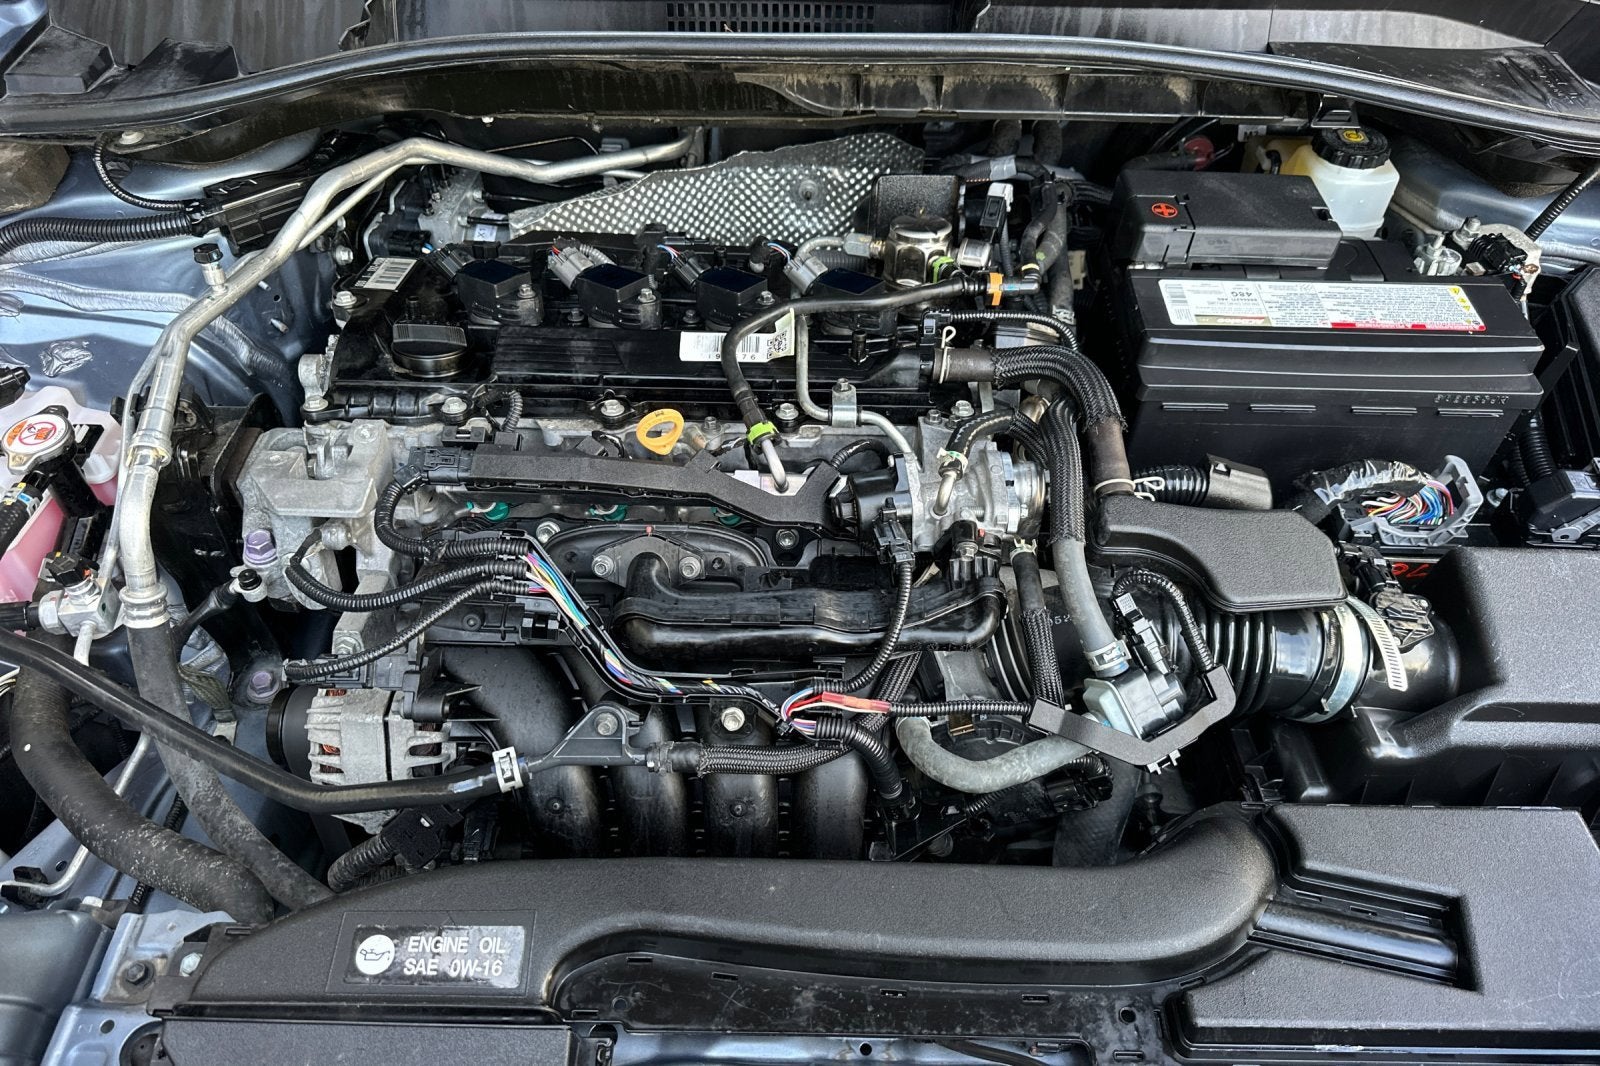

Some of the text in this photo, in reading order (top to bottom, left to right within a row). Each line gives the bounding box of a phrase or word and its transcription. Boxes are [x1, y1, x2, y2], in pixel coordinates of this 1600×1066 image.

[407, 936, 506, 954] ENGINE OIL
[403, 957, 503, 977] SAE 0W-16
